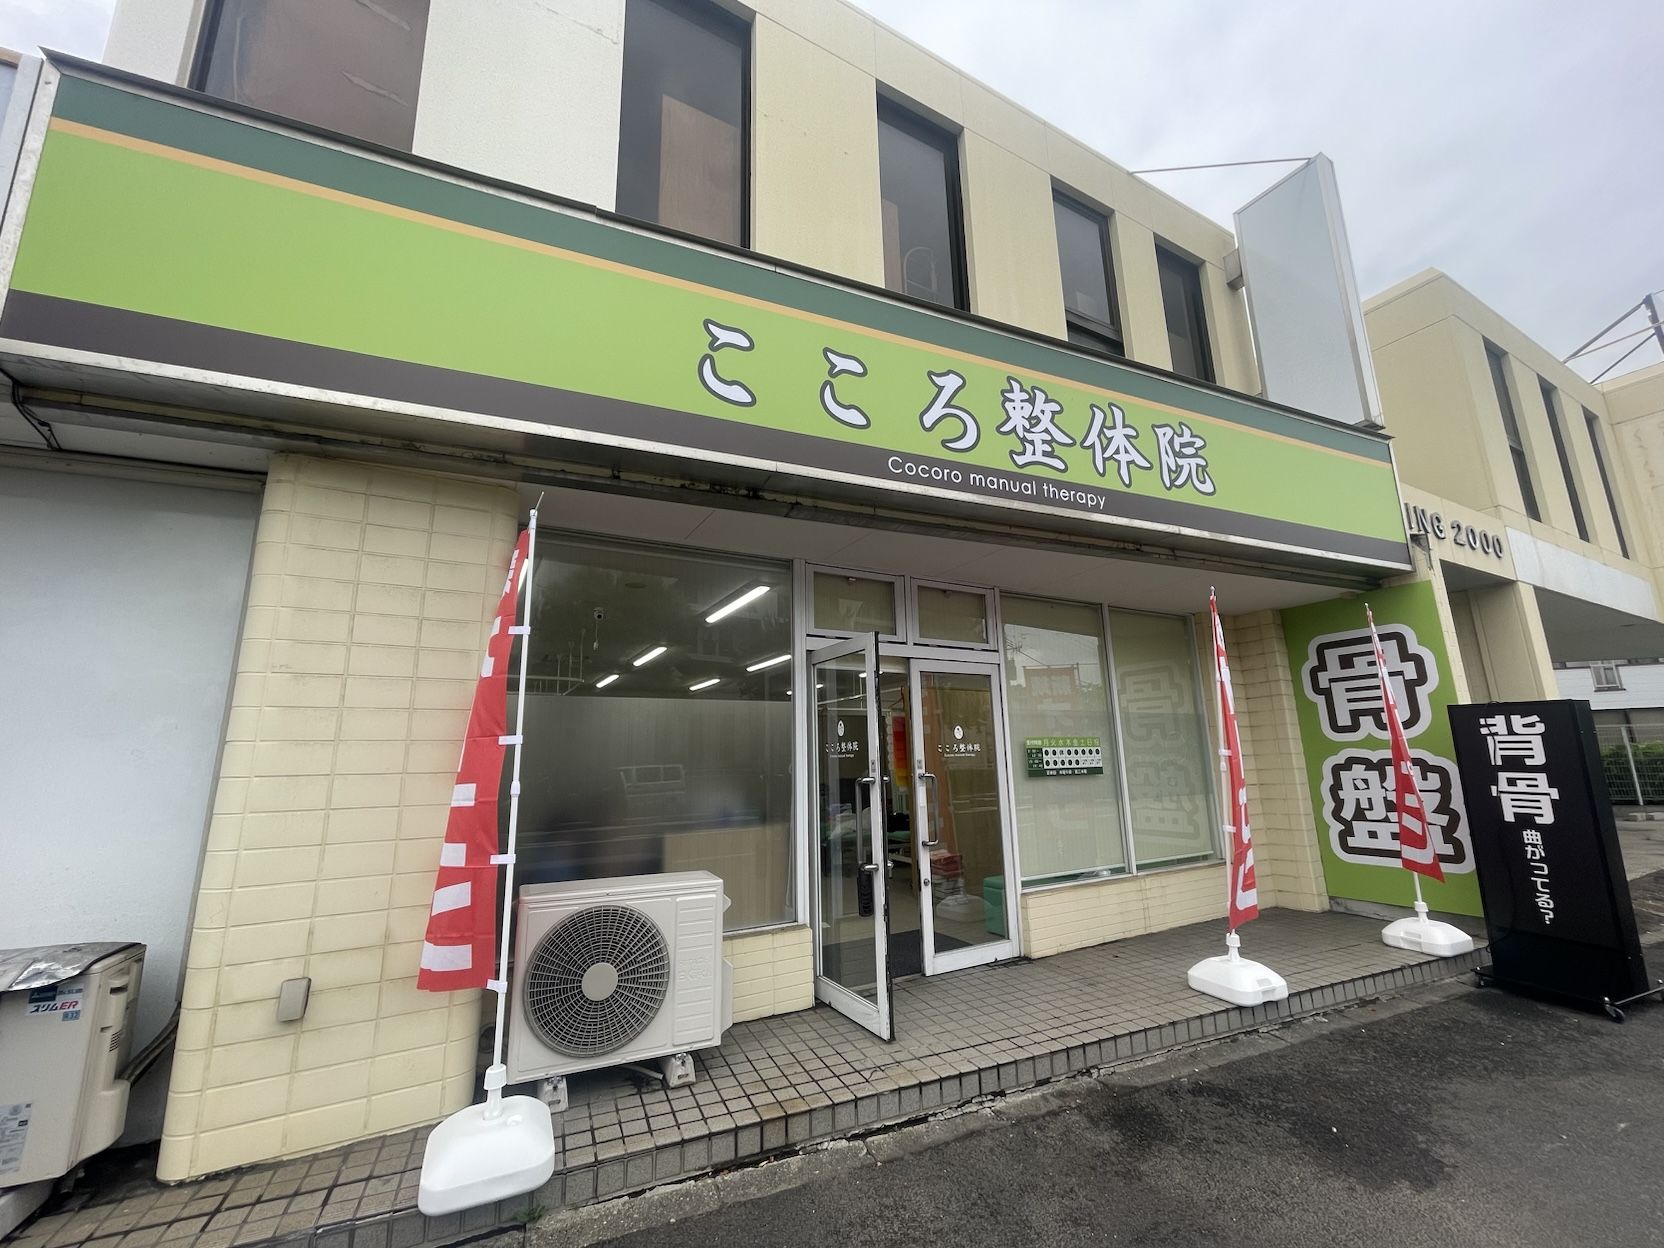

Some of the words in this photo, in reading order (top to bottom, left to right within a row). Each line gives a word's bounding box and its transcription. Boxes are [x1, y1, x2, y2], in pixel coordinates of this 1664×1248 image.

[699, 319, 1216, 496] こころ整体院
[887, 456, 963, 483] Cocoro
[969, 472, 1037, 496] manual
[1042, 482, 1106, 510] therapy
[1450, 519, 1503, 559] 2000
